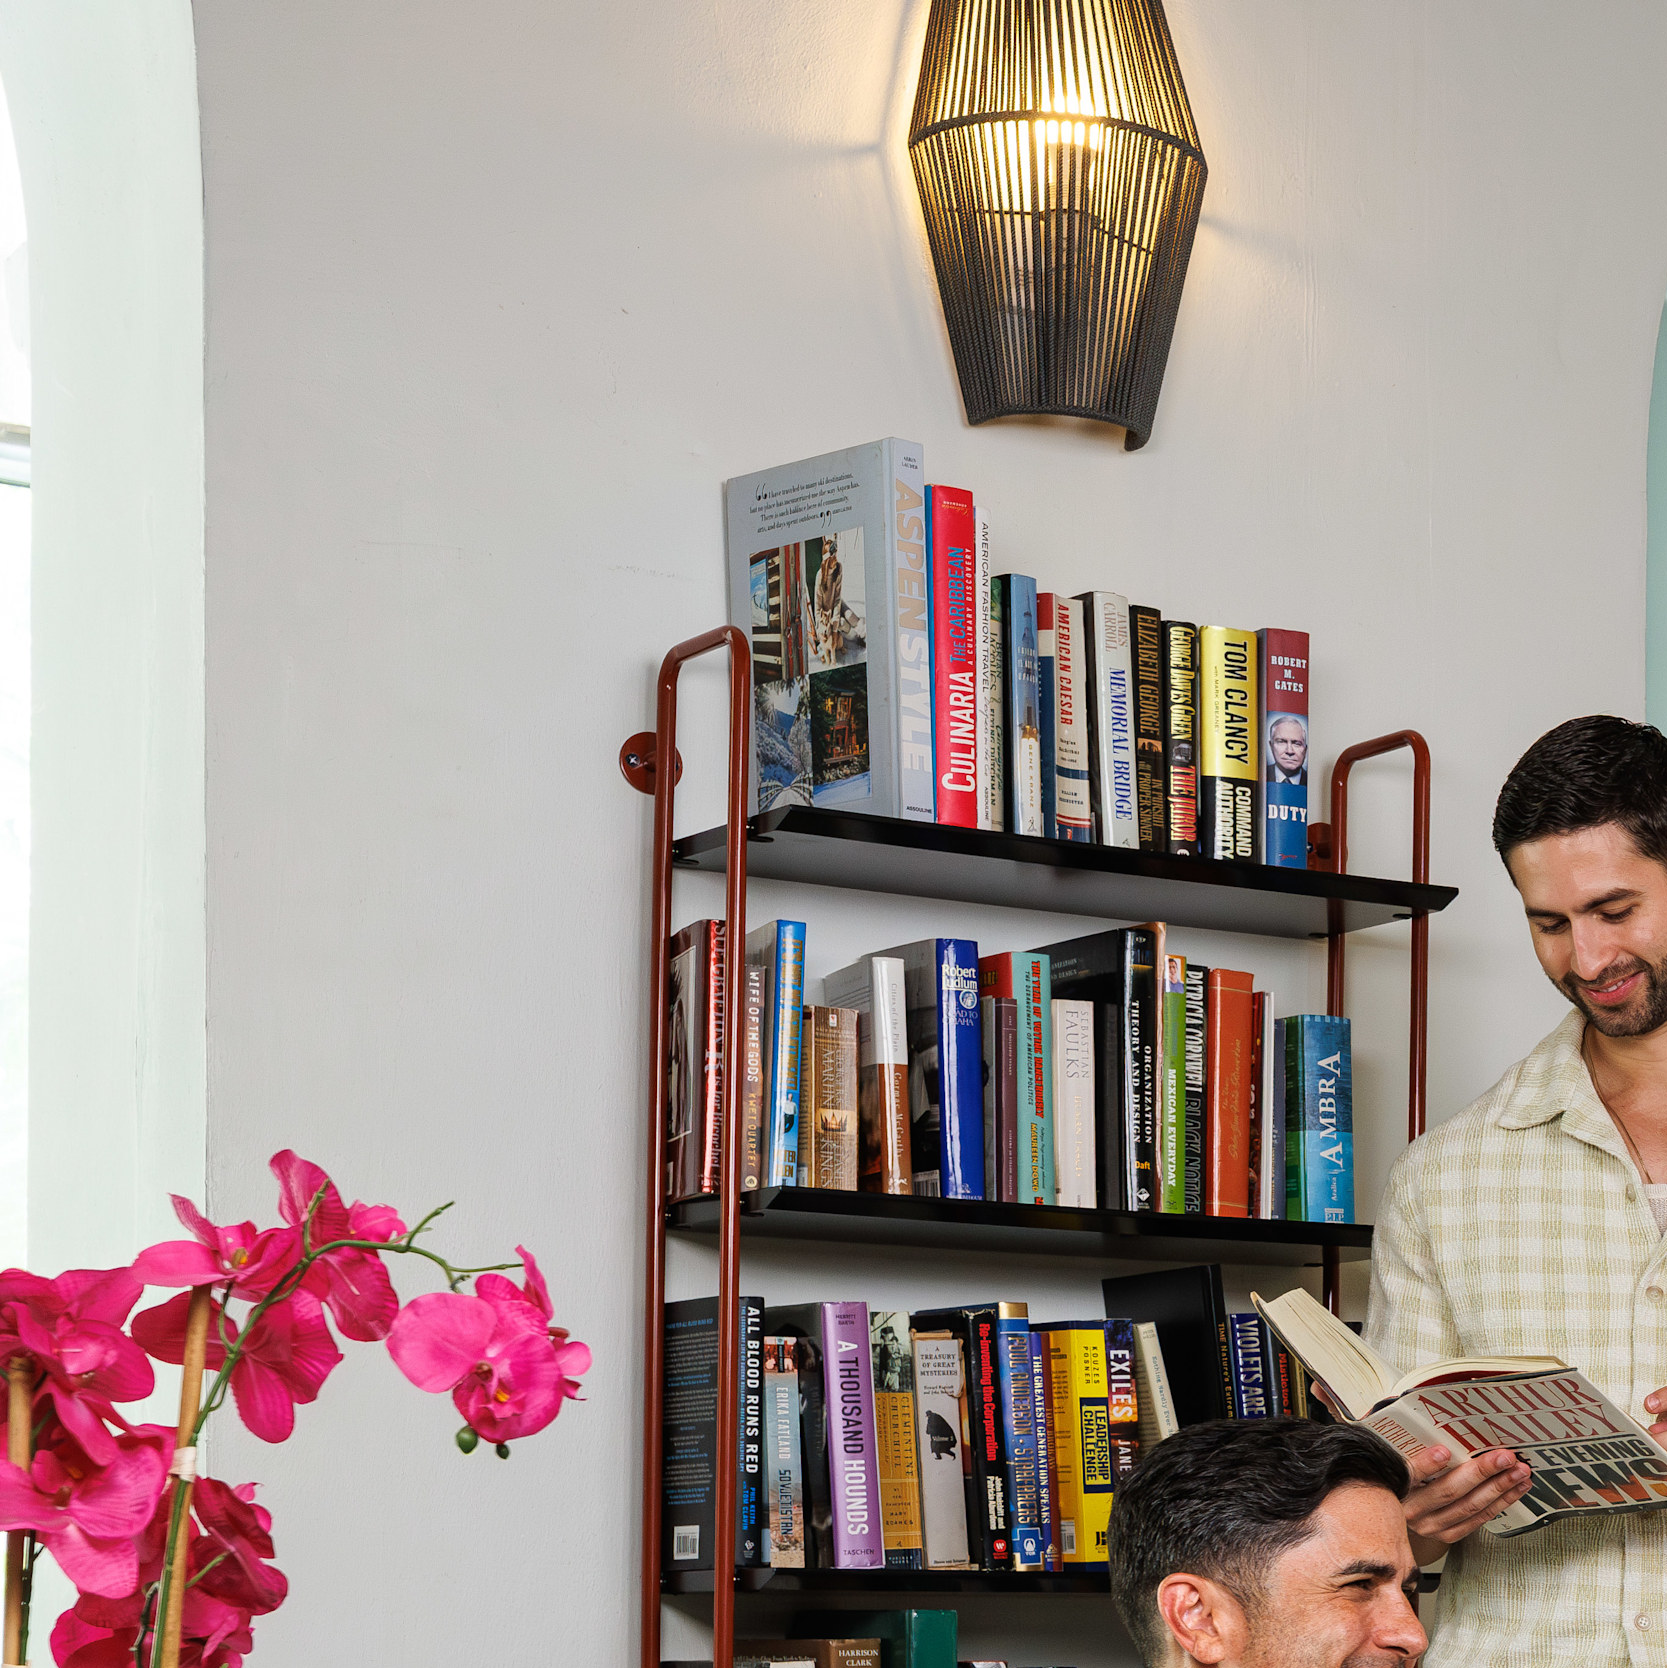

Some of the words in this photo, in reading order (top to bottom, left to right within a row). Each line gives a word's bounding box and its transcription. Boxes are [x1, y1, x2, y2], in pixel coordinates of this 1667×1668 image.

[965, 548, 973, 602] DISCOVERY
[981, 522, 990, 587] AMERICAN
[947, 546, 966, 641] CARIBBEAN
[982, 590, 990, 644] FASHION
[965, 607, 974, 654] CULINARY
[1057, 603, 1071, 673] AMERICAN
[1103, 602, 1118, 652] CARROLL
[1117, 611, 1128, 648] JAMES
[1137, 614, 1158, 682] ELIZABETH
[1169, 626, 1195, 669] GEORGE
[950, 640, 967, 663] THE
[982, 649, 990, 693] TRAVEL
[1224, 641, 1248, 682] TOM
[1270, 655, 1307, 669] ROBERT
[1283, 669, 1295, 679] M.
[1059, 677, 1073, 726] CAESAR
[1169, 668, 1195, 704] DAWES
[1274, 680, 1304, 693] GATES
[941, 671, 976, 793] CULINARIA
[1109, 667, 1130, 755] MEMORIAL
[1139, 684, 1161, 738] GEORGE
[1170, 702, 1195, 742] GREEN
[1224, 688, 1249, 765] CLANCY
[1113, 759, 1133, 821] BRIDGE
[1169, 765, 1197, 796] THE
[906, 805, 933, 814] ASSOULINE
[1167, 795, 1197, 842] JUROR
[1216, 781, 1235, 860] AUTHORITY
[1235, 785, 1252, 857] COMMAND
[1267, 804, 1307, 823] DUTY
[748, 972, 760, 1003] WIFE
[942, 964, 976, 978] Robert
[943, 976, 978, 990] Ludlum
[1031, 961, 1041, 974] THE
[1032, 976, 1041, 1005] YEAR
[748, 1008, 759, 1024] OF
[1033, 1007, 1042, 1019] OF
[1186, 971, 1204, 1026] PATRICIA
[748, 1026, 759, 1048] THE
[1033, 1021, 1043, 1055] VOTING
[1065, 1010, 1080, 1079] FAULKS
[1080, 1010, 1090, 1079] SEBASTIAN
[1131, 1000, 1140, 1053] THEORY
[747, 1050, 759, 1083] GODS
[1131, 1059, 1140, 1087] AND
[1185, 1027, 1204, 1093] CORNWELL
[1034, 1057, 1044, 1119] DANGEROUSLY
[1144, 1045, 1153, 1144] ORGANIZATION
[1168, 1068, 1177, 1123] MEXICAN
[1317, 1050, 1344, 1168] AMBRA
[1132, 1094, 1141, 1143] DESIGN
[1185, 1098, 1201, 1157] BLACK
[1030, 1122, 1038, 1163] MAUREEN
[1135, 1160, 1151, 1171] Daft
[1167, 1126, 1177, 1187] EVERYDAY
[1185, 1156, 1201, 1213] NOTICE
[747, 1306, 760, 1334] ALL
[1217, 1322, 1227, 1343] TIME
[747, 1340, 760, 1389] BLOOD
[837, 1340, 858, 1353] A
[979, 1323, 994, 1385] Re-inventing
[1008, 1336, 1028, 1368] POUL
[1033, 1355, 1042, 1374] THE
[1083, 1346, 1091, 1384] POSNER
[1092, 1346, 1100, 1384] KOUZES
[1221, 1345, 1229, 1382] Nature's
[1236, 1320, 1263, 1383] VIOLETS
[776, 1387, 789, 1416] ERIKA
[838, 1357, 864, 1454] THOUSAND
[983, 1385, 995, 1402] the
[1011, 1372, 1033, 1436] ANDERSON
[1034, 1376, 1045, 1423] GREATEST
[1110, 1350, 1133, 1418] EXILES
[1241, 1385, 1266, 1416] ARE
[1418, 1377, 1599, 1426] ARTHUR
[746, 1395, 759, 1437] RUNS
[777, 1418, 791, 1459] FATLAND
[891, 1396, 901, 1469] CHURCHILL
[901, 1396, 914, 1477] CLEMENTINE
[984, 1403, 999, 1461] Corporation
[1441, 1404, 1625, 1454] HAILEY
[745, 1444, 758, 1474] RED
[1036, 1426, 1049, 1485] GENERATION
[1083, 1410, 1097, 1481] CHALLENGE
[1095, 1410, 1109, 1480] LEADERSHIP
[1118, 1439, 1132, 1472] JANE
[1541, 1438, 1655, 1468] EVENING
[779, 1469, 793, 1535] SOVJETISTAN
[843, 1459, 869, 1535] HOUNDS
[1014, 1448, 1038, 1524] STARFARERS
[1040, 1488, 1050, 1524] SPEAKS
[846, 1659, 872, 1667] CLARK
